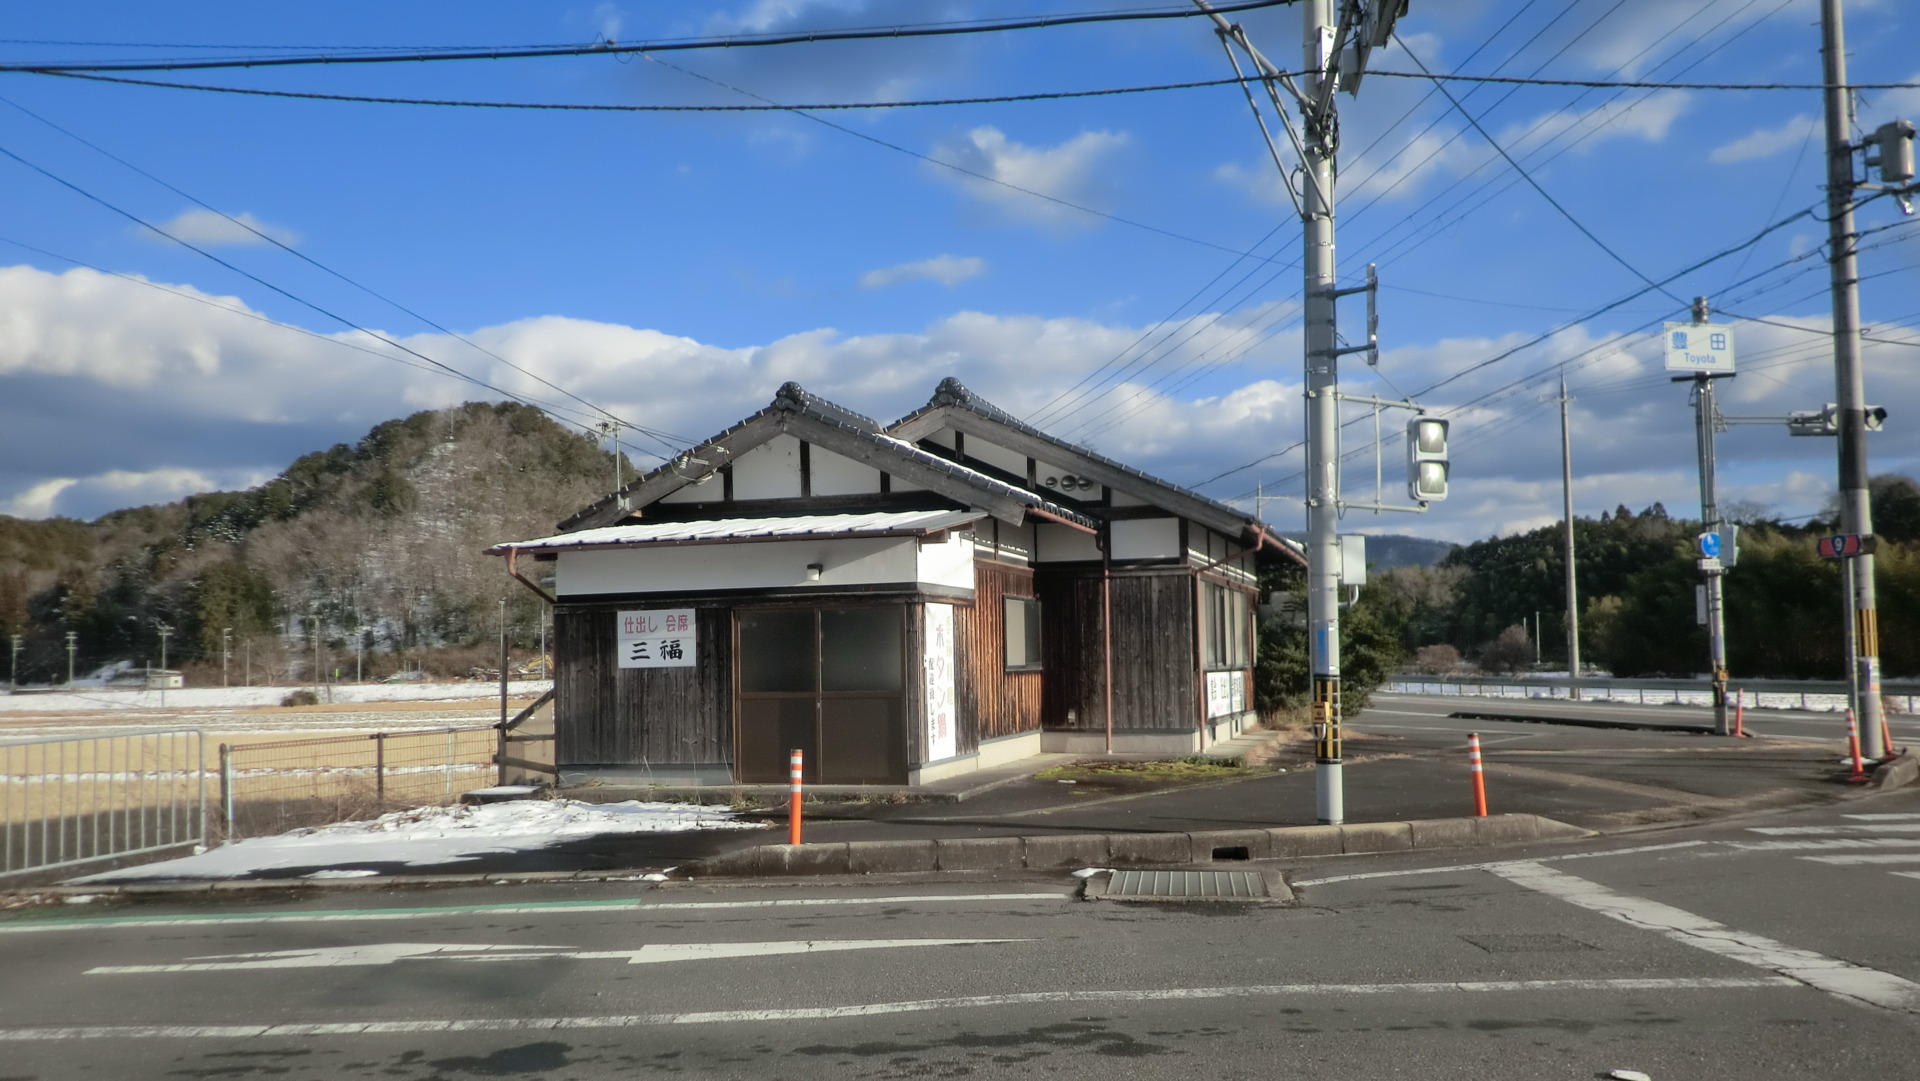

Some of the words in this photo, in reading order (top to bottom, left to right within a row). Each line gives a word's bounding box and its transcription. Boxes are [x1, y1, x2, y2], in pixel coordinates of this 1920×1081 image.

[1672, 331, 1726, 350] 豊田
[1684, 352, 1716, 365] Toyota
[1834, 537, 1843, 551] 9
[624, 615, 658, 634] 仕出し
[665, 613, 689, 632] 会席
[630, 639, 684, 660] 三福
